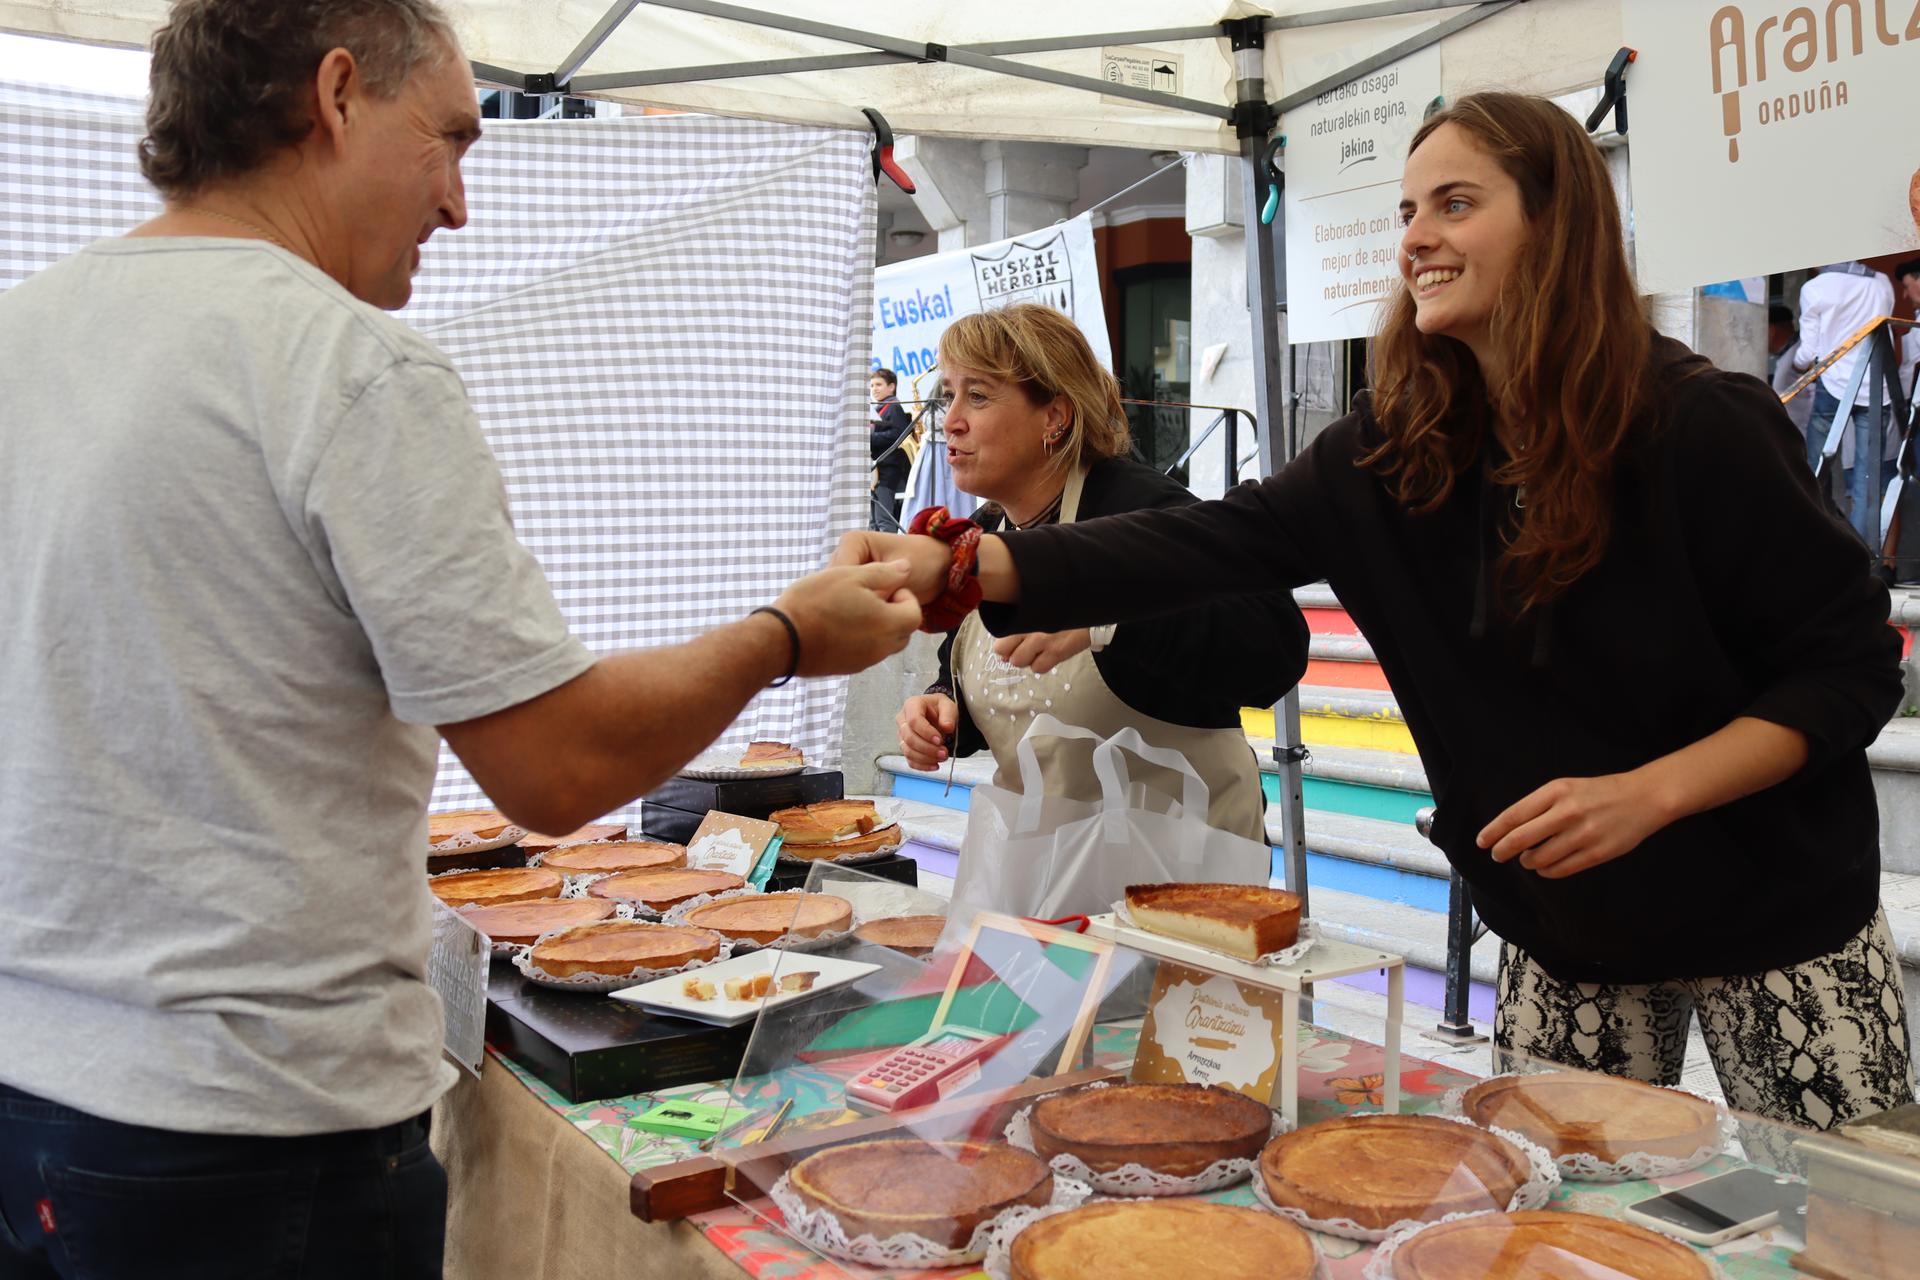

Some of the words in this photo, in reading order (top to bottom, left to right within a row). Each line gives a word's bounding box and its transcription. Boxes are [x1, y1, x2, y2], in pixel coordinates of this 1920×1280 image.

[1361, 67, 1399, 95] osagai
[1758, 80, 1849, 125] ORDUÑA
[1310, 108, 1370, 137] naturalekin
[1374, 101, 1407, 125] egina,
[1340, 138, 1375, 164] jakina
[1315, 218, 1367, 243] Elaborado
[1370, 217, 1390, 234] con
[1322, 252, 1351, 274] mejor
[1355, 248, 1368, 266] de
[879, 284, 954, 330] Euskal
[892, 344, 938, 377] Ano
